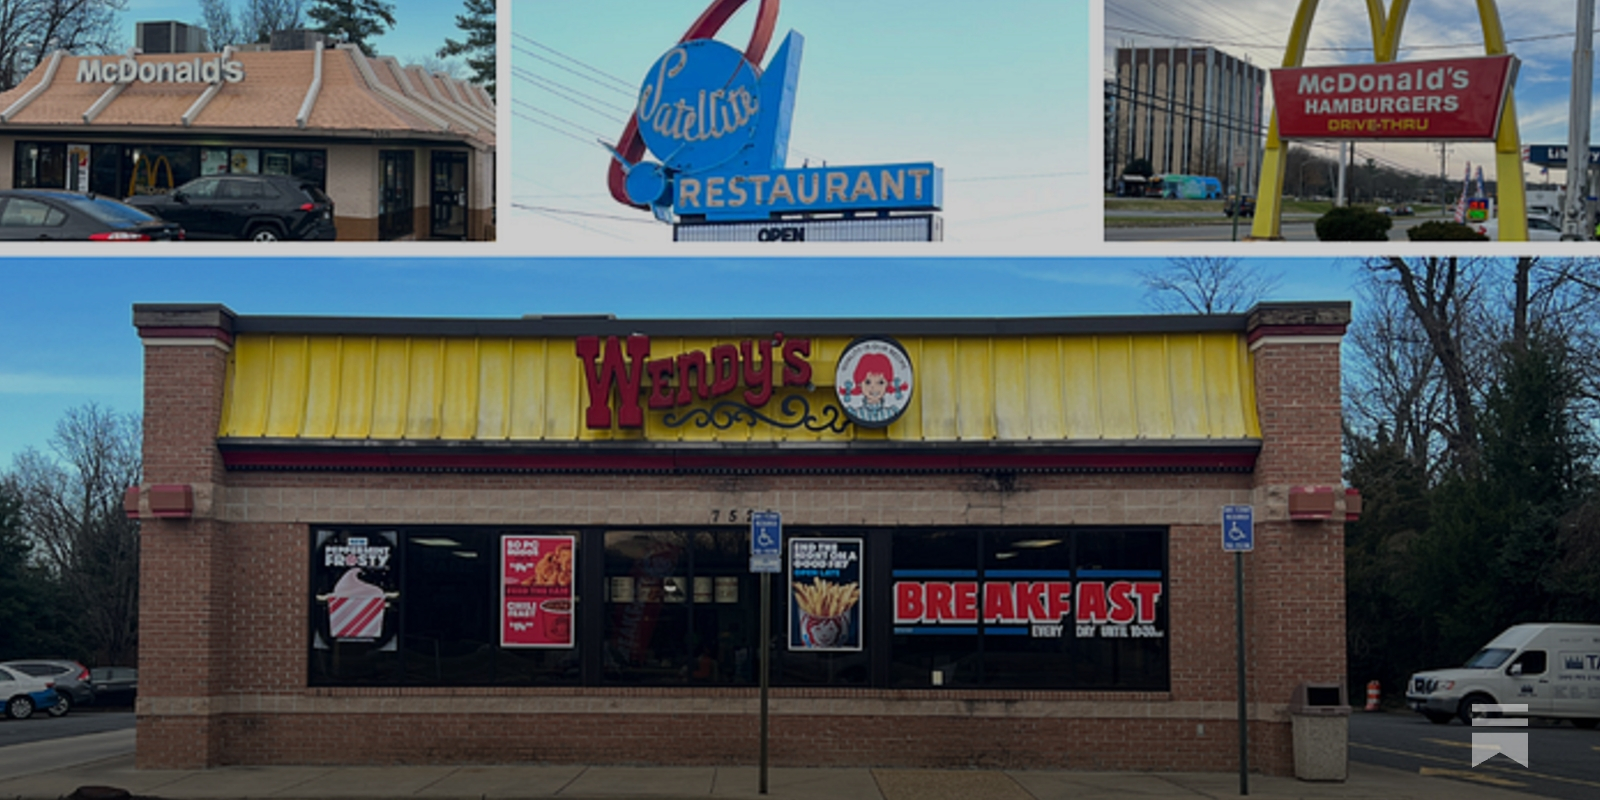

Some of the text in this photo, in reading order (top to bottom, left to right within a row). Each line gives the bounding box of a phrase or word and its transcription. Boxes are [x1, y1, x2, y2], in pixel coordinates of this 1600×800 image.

[76, 58, 245, 84] McDonald's
[1298, 67, 1469, 95] McDonald's
[640, 48, 759, 142] Satellite
[1305, 95, 1459, 114] HAMBURGERS
[1327, 118, 1429, 131] DRIVE-THRU
[679, 168, 930, 208] RESTAURANT
[757, 227, 805, 242] OPEN
[848, 551, 858, 561] A
[893, 581, 1162, 625] BREAKFAST
[1031, 625, 1064, 638] EVERY
[1076, 625, 1096, 638] DAY
[1101, 625, 1129, 638] UNTIL
